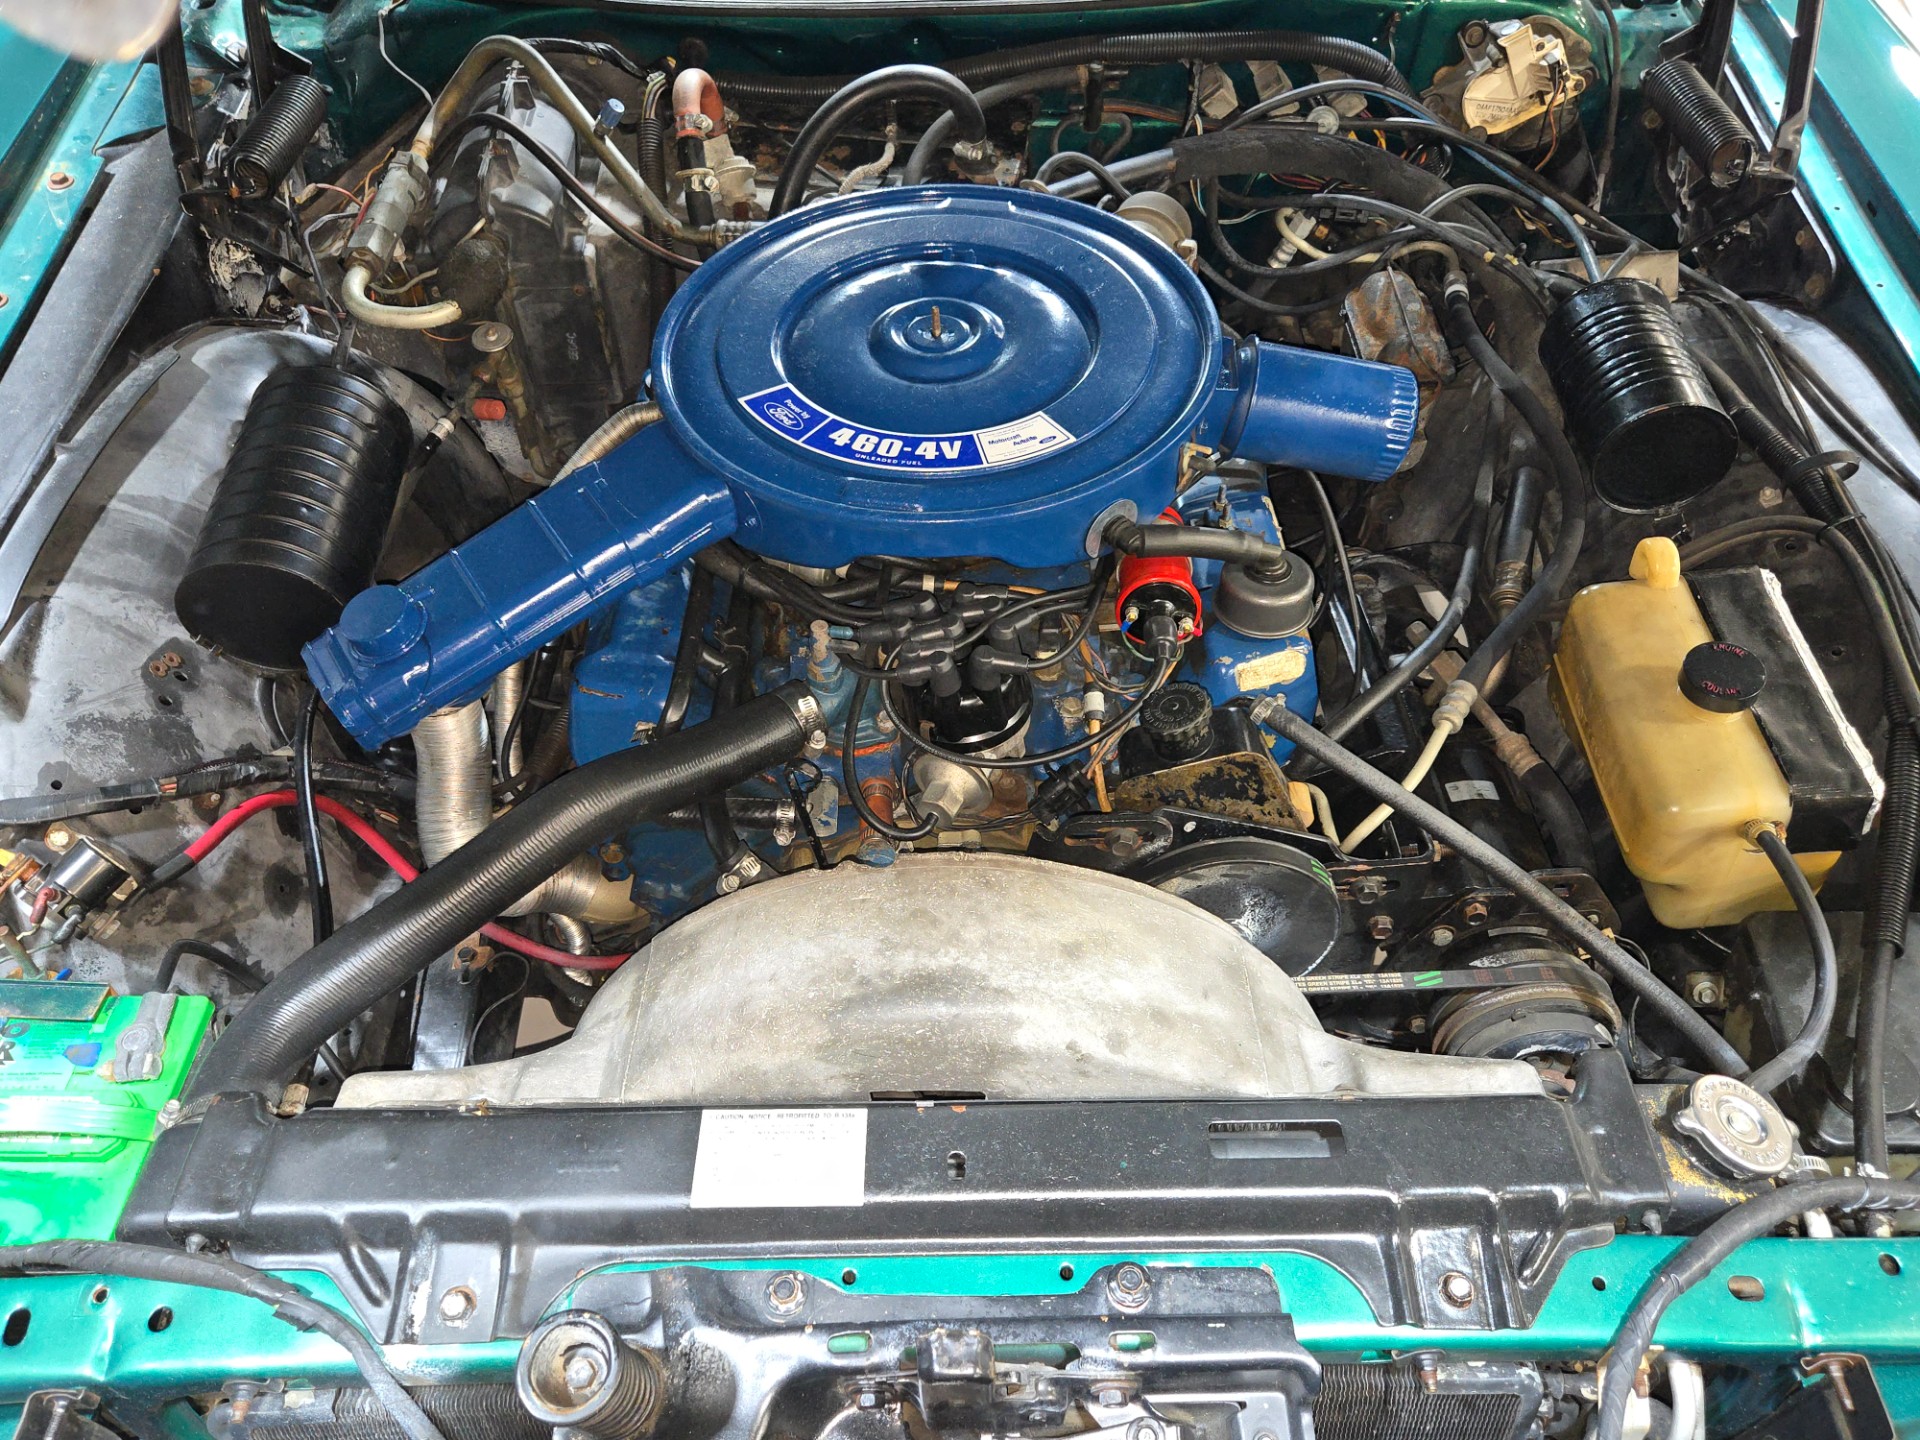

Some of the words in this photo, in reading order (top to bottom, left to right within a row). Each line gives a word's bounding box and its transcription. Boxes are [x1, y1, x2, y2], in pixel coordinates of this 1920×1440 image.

[769, 407, 798, 426] Ford
[784, 399, 803, 413] Power
[801, 411, 811, 420] by
[828, 427, 962, 460] 460-4V
[855, 453, 899, 464] UNLEADED
